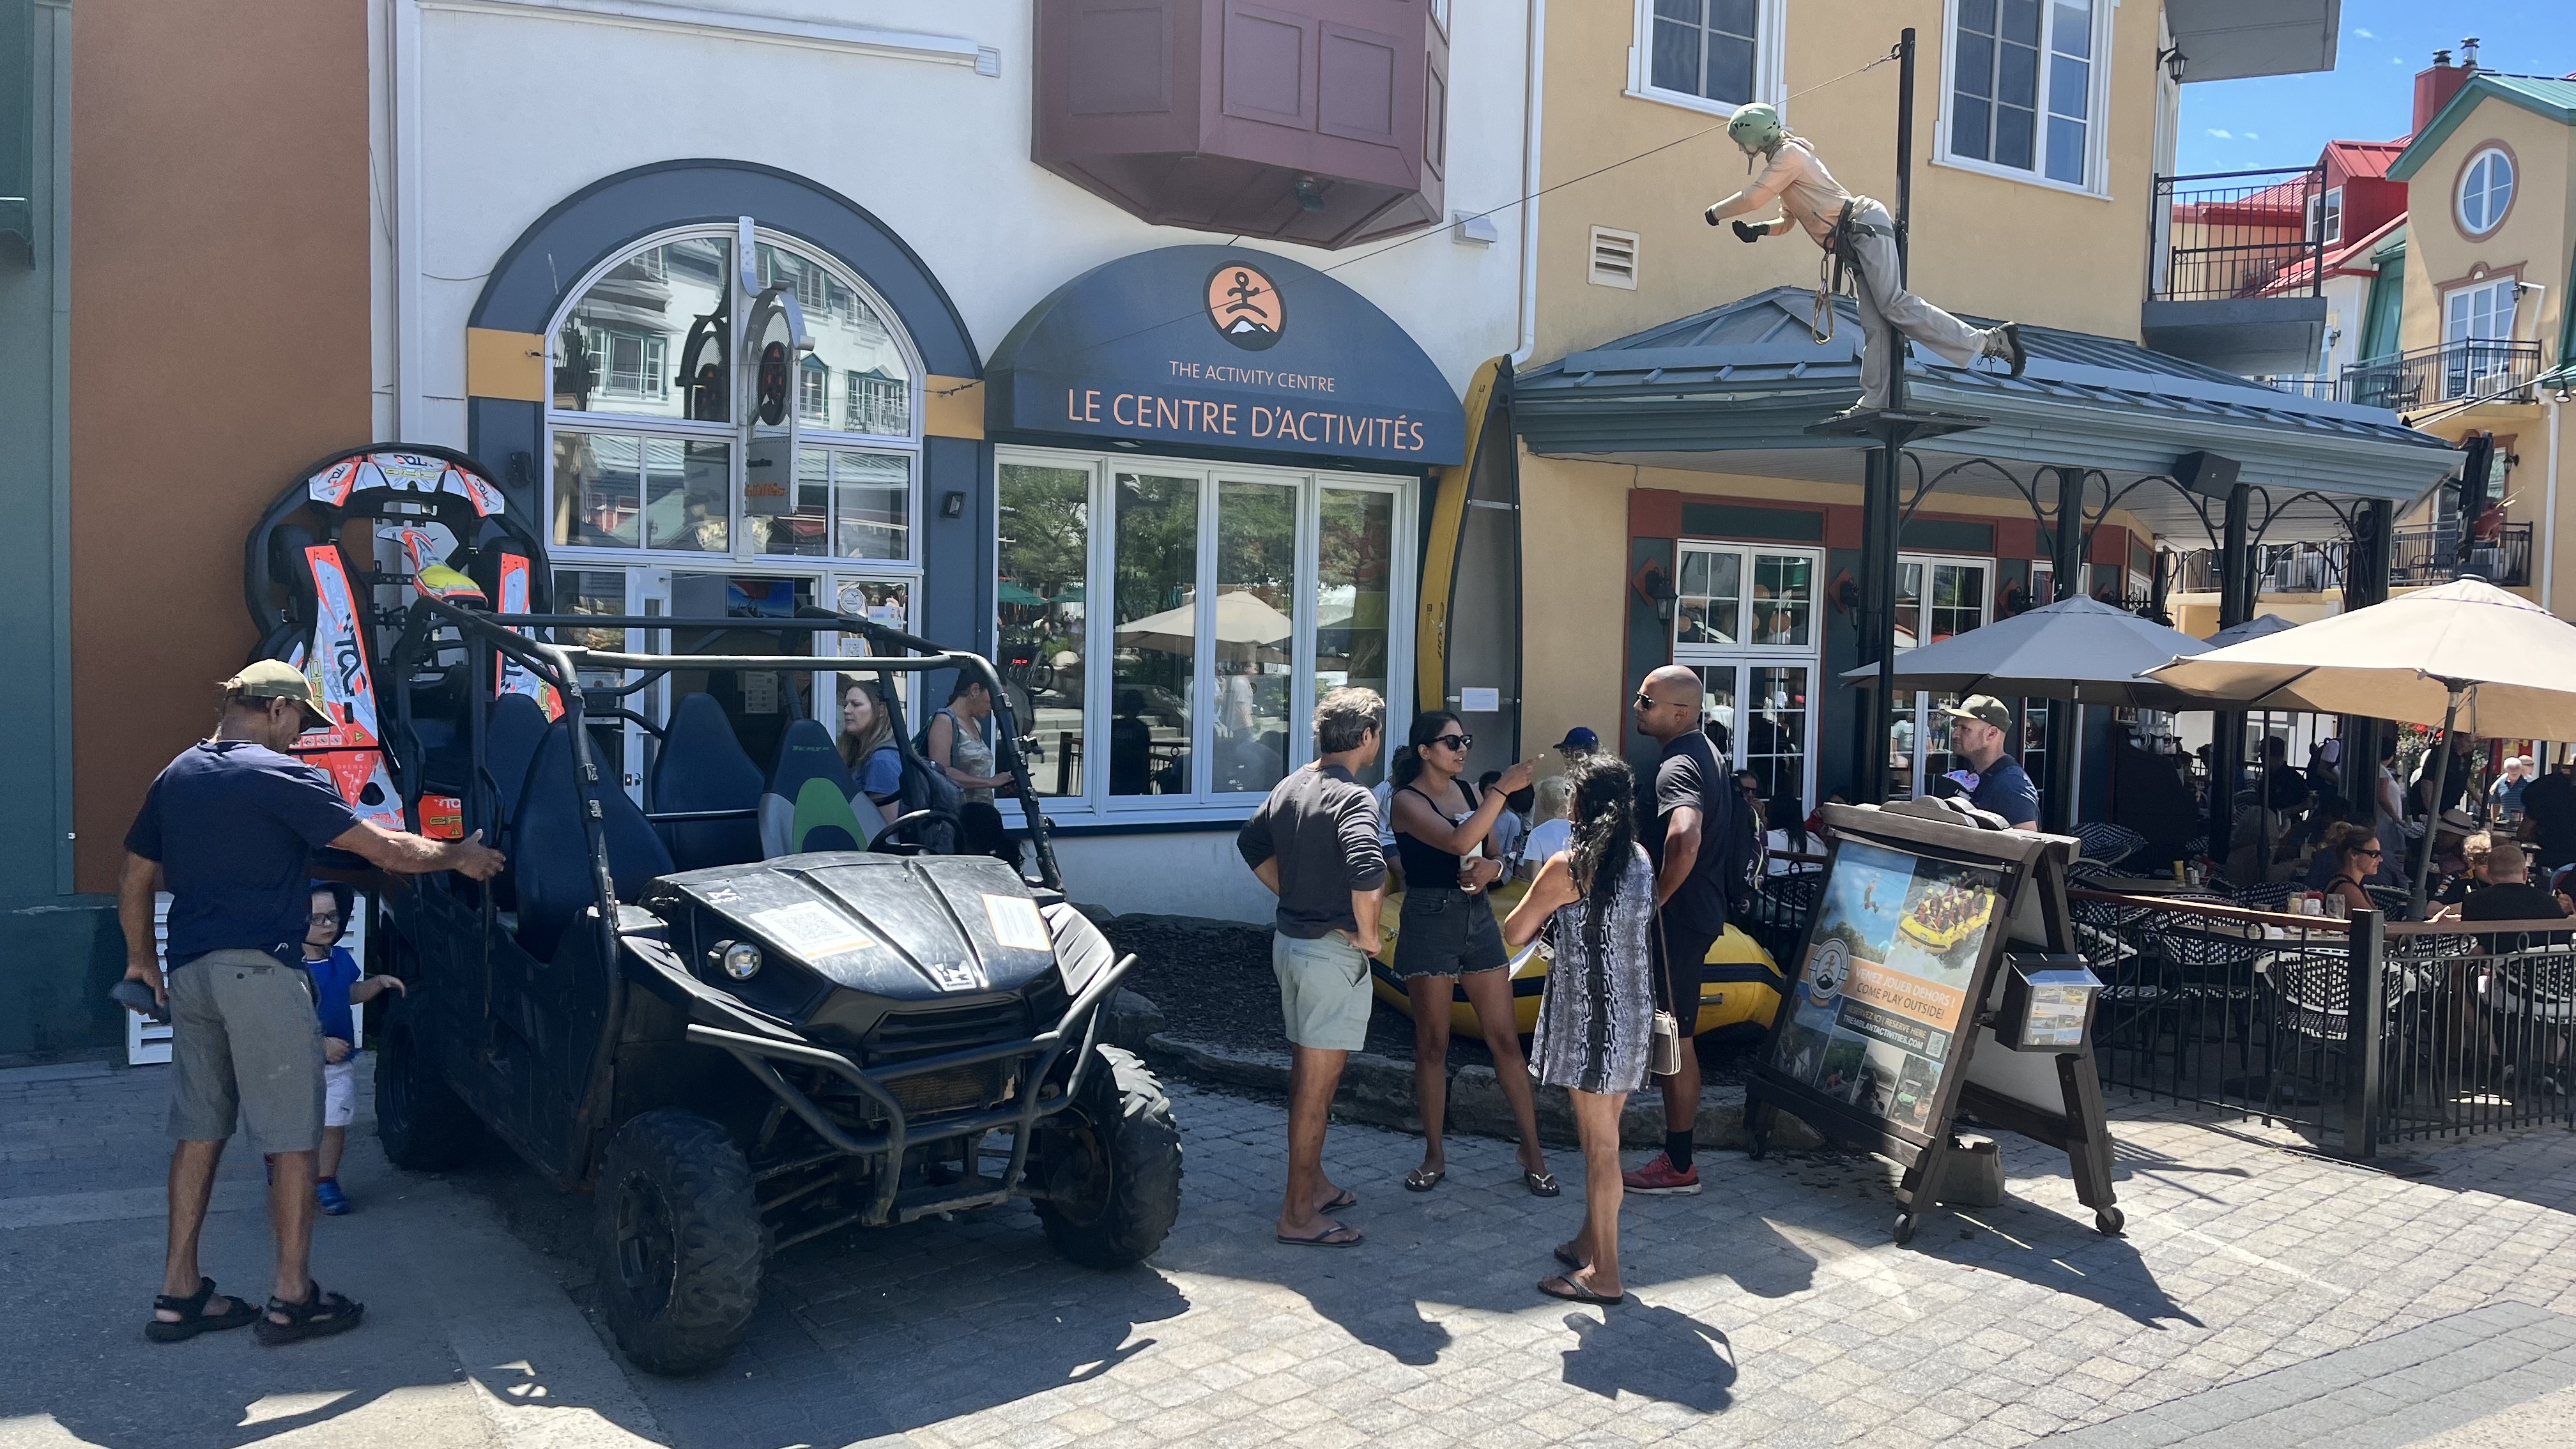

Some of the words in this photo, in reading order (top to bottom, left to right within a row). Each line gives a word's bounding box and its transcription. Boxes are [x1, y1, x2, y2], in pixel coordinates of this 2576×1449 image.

[1169, 360, 1200, 378] THE
[1205, 365, 1274, 386] ACTIVITY
[1278, 372, 1335, 392] CENTRE
[1068, 388, 1101, 423] LE
[1113, 394, 1238, 435] CENTRE
[1251, 406, 1424, 451] D'ACTIVITÉS
[429, 815, 462, 826] CR
[1855, 967, 1883, 985] VENEZ
[1883, 977, 1912, 995] JOUER
[1912, 985, 1950, 1006] DEHORS
[1857, 983, 1882, 999] COME
[1882, 990, 1904, 1006] PLAY
[1903, 998, 1945, 1020] OUTSIDE!
[1843, 1014, 1924, 1050] TREMBLANTACTIVITIES.COM
[1885, 1017, 1911, 1034] RESERVE
[1910, 1025, 1928, 1039] HERE
